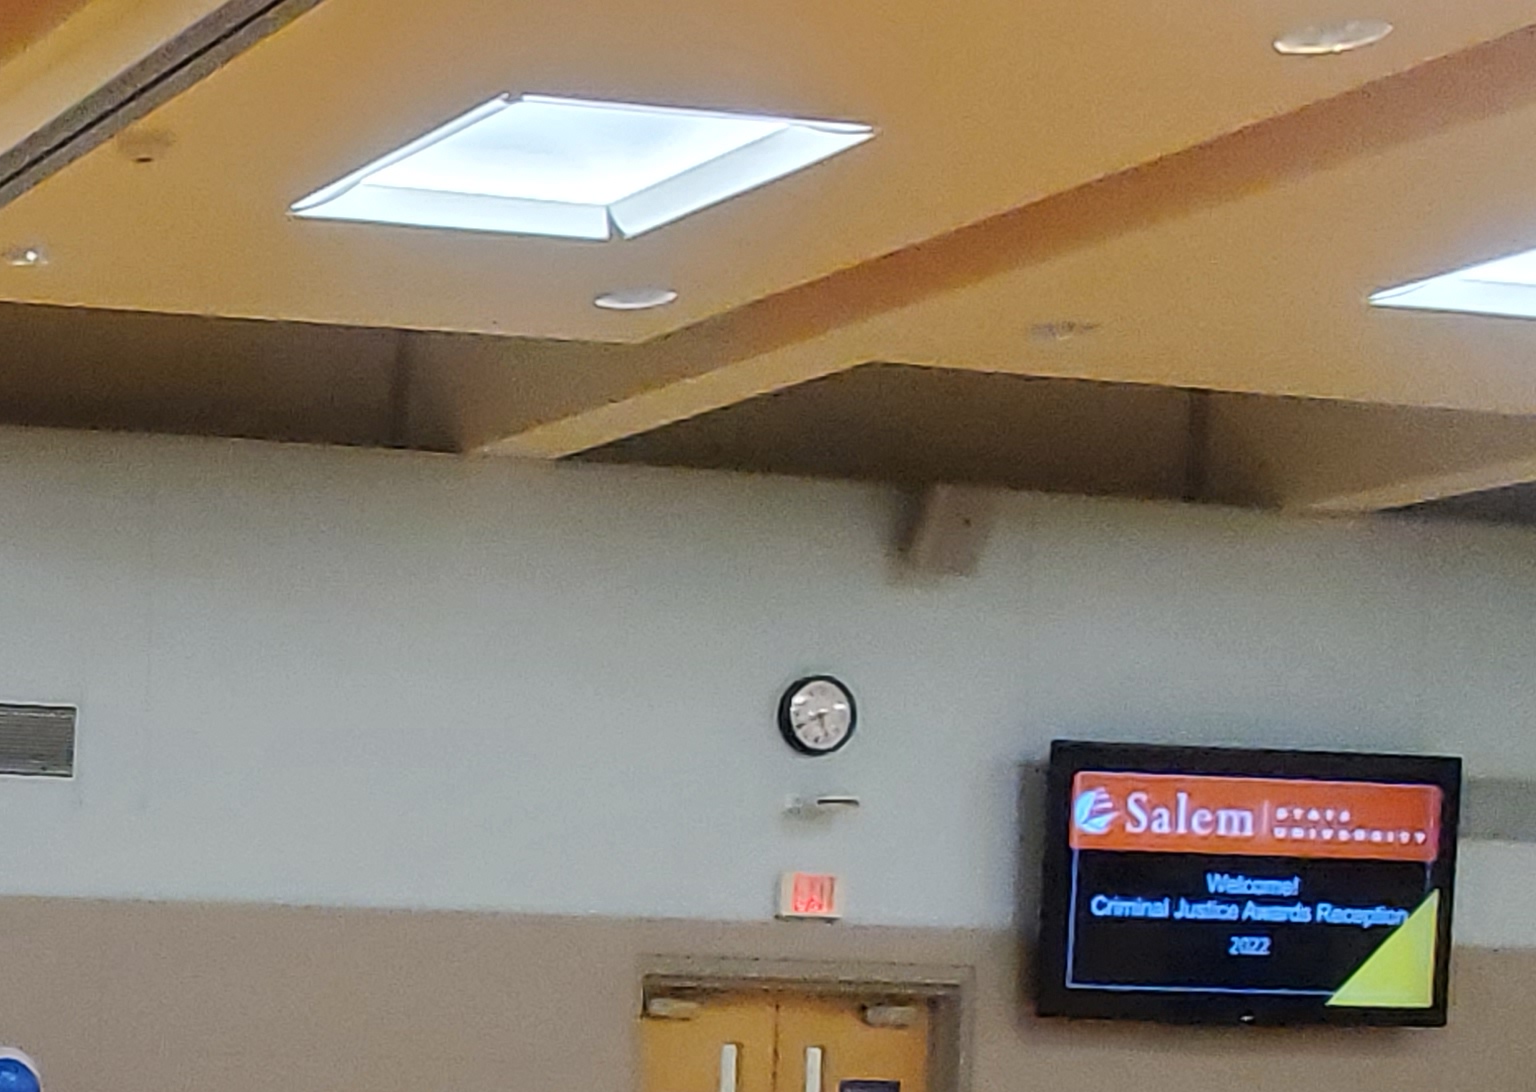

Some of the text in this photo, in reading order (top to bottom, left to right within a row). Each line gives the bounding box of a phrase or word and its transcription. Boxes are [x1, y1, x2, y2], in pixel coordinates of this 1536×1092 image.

[1124, 791, 1255, 837] Salem
[1275, 806, 1352, 823] STATE
[1206, 872, 1302, 896] Welcome!
[1090, 894, 1409, 929] Criminal Justice Awards Reception
[1229, 935, 1272, 956] 2022
